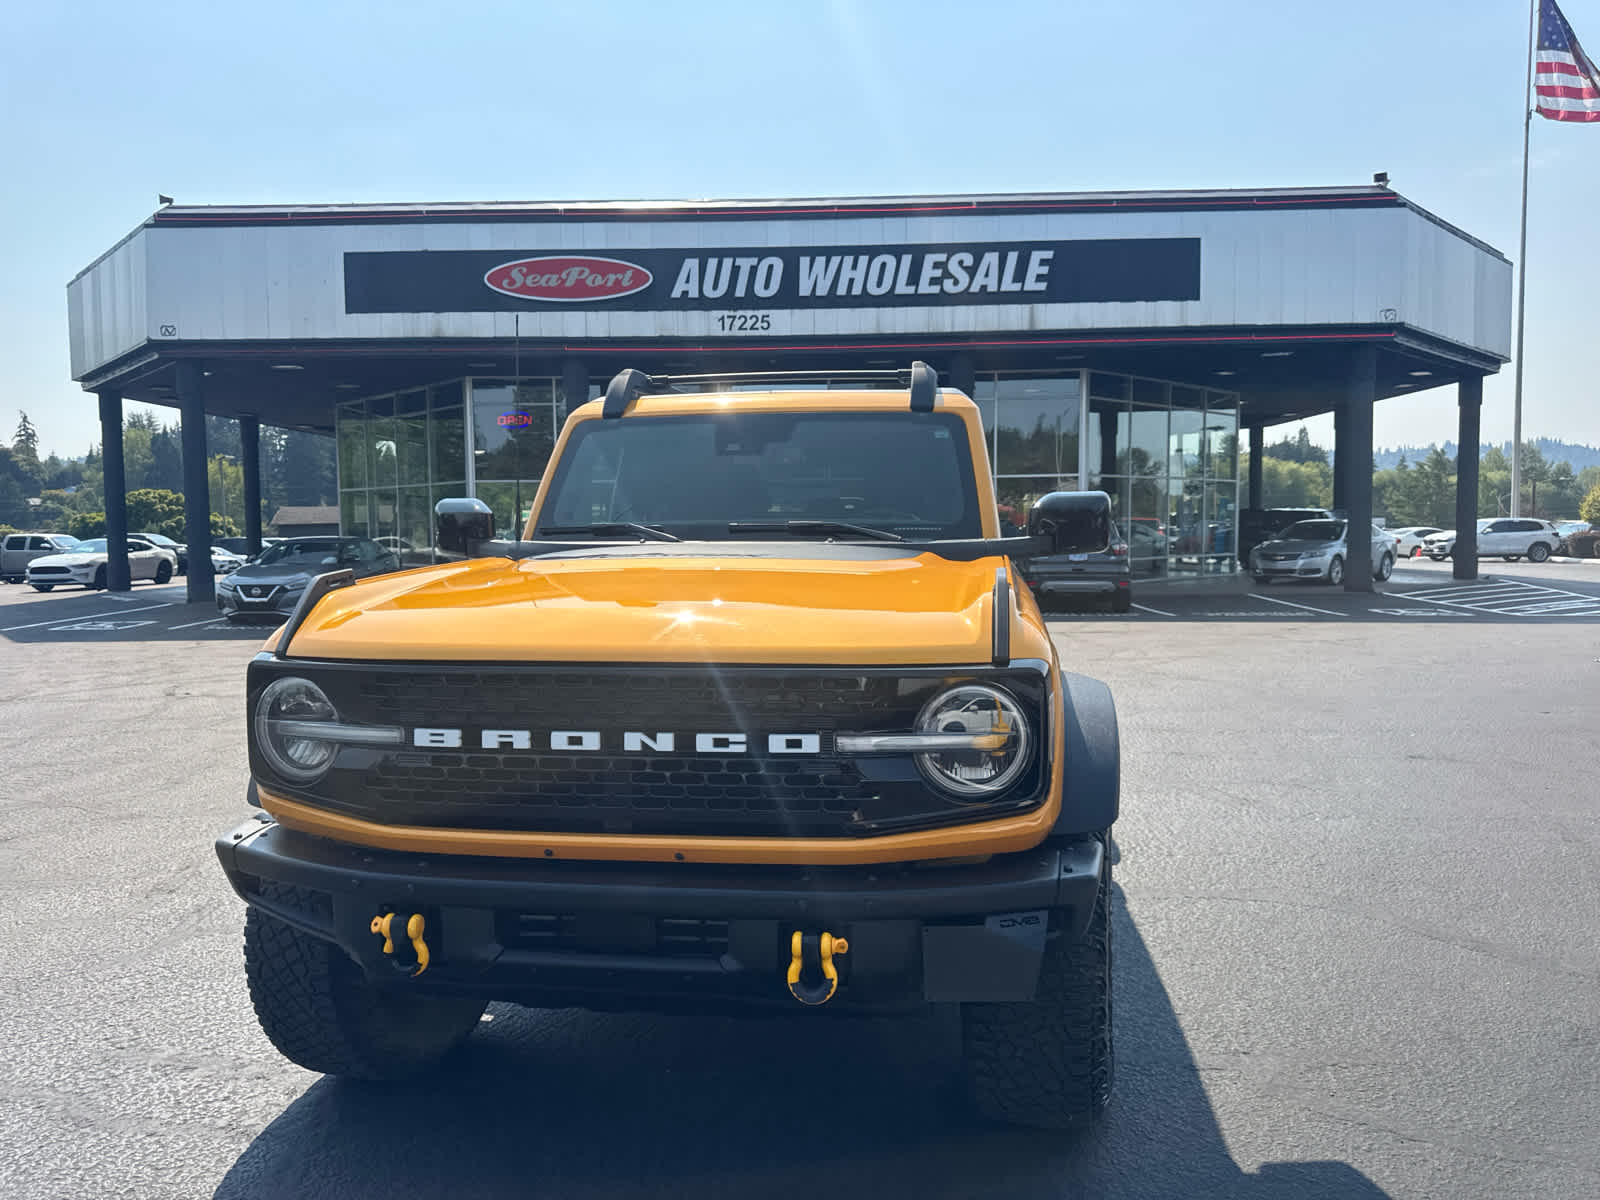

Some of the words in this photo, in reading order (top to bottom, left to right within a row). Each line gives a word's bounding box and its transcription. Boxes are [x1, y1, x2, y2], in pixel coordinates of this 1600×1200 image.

[502, 266, 633, 289] SeaPort
[670, 256, 784, 298] AUTO
[798, 250, 1054, 296] WHOLESALE
[717, 314, 771, 331] 17225
[496, 415, 533, 425] OPEN
[413, 728, 820, 753] BRONCO
